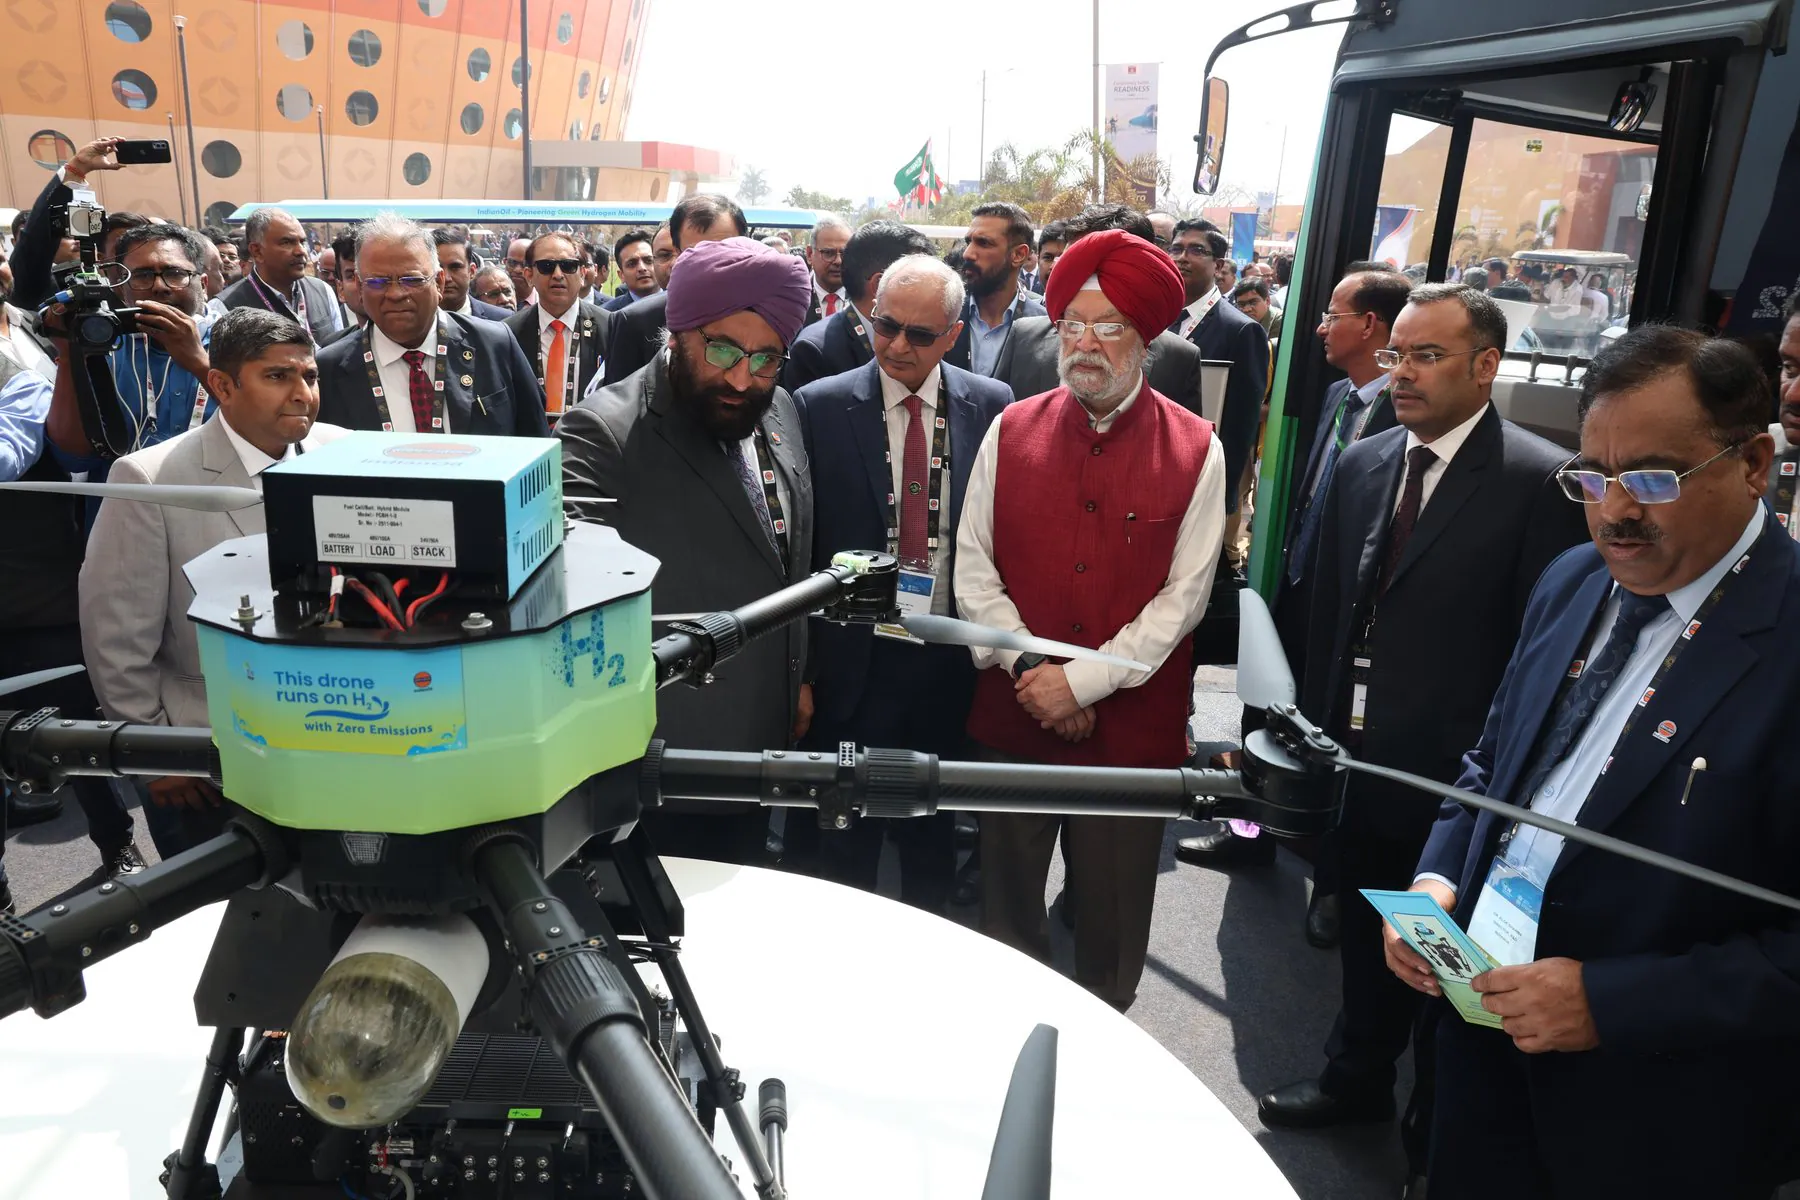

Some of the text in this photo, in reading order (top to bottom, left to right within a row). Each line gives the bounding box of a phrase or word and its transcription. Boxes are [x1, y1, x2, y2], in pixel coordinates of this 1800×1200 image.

[517, 209, 556, 217] Pioneering
[581, 209, 617, 217] Hydrogen
[617, 209, 646, 218] Mobility
[324, 544, 355, 555] BATTERY
[370, 545, 396, 557] LOAD
[413, 546, 446, 557] STACK
[273, 671, 375, 690] This drone
[276, 689, 319, 704] runs
[323, 691, 348, 706] on
[304, 722, 433, 737] with Zero Emissions
